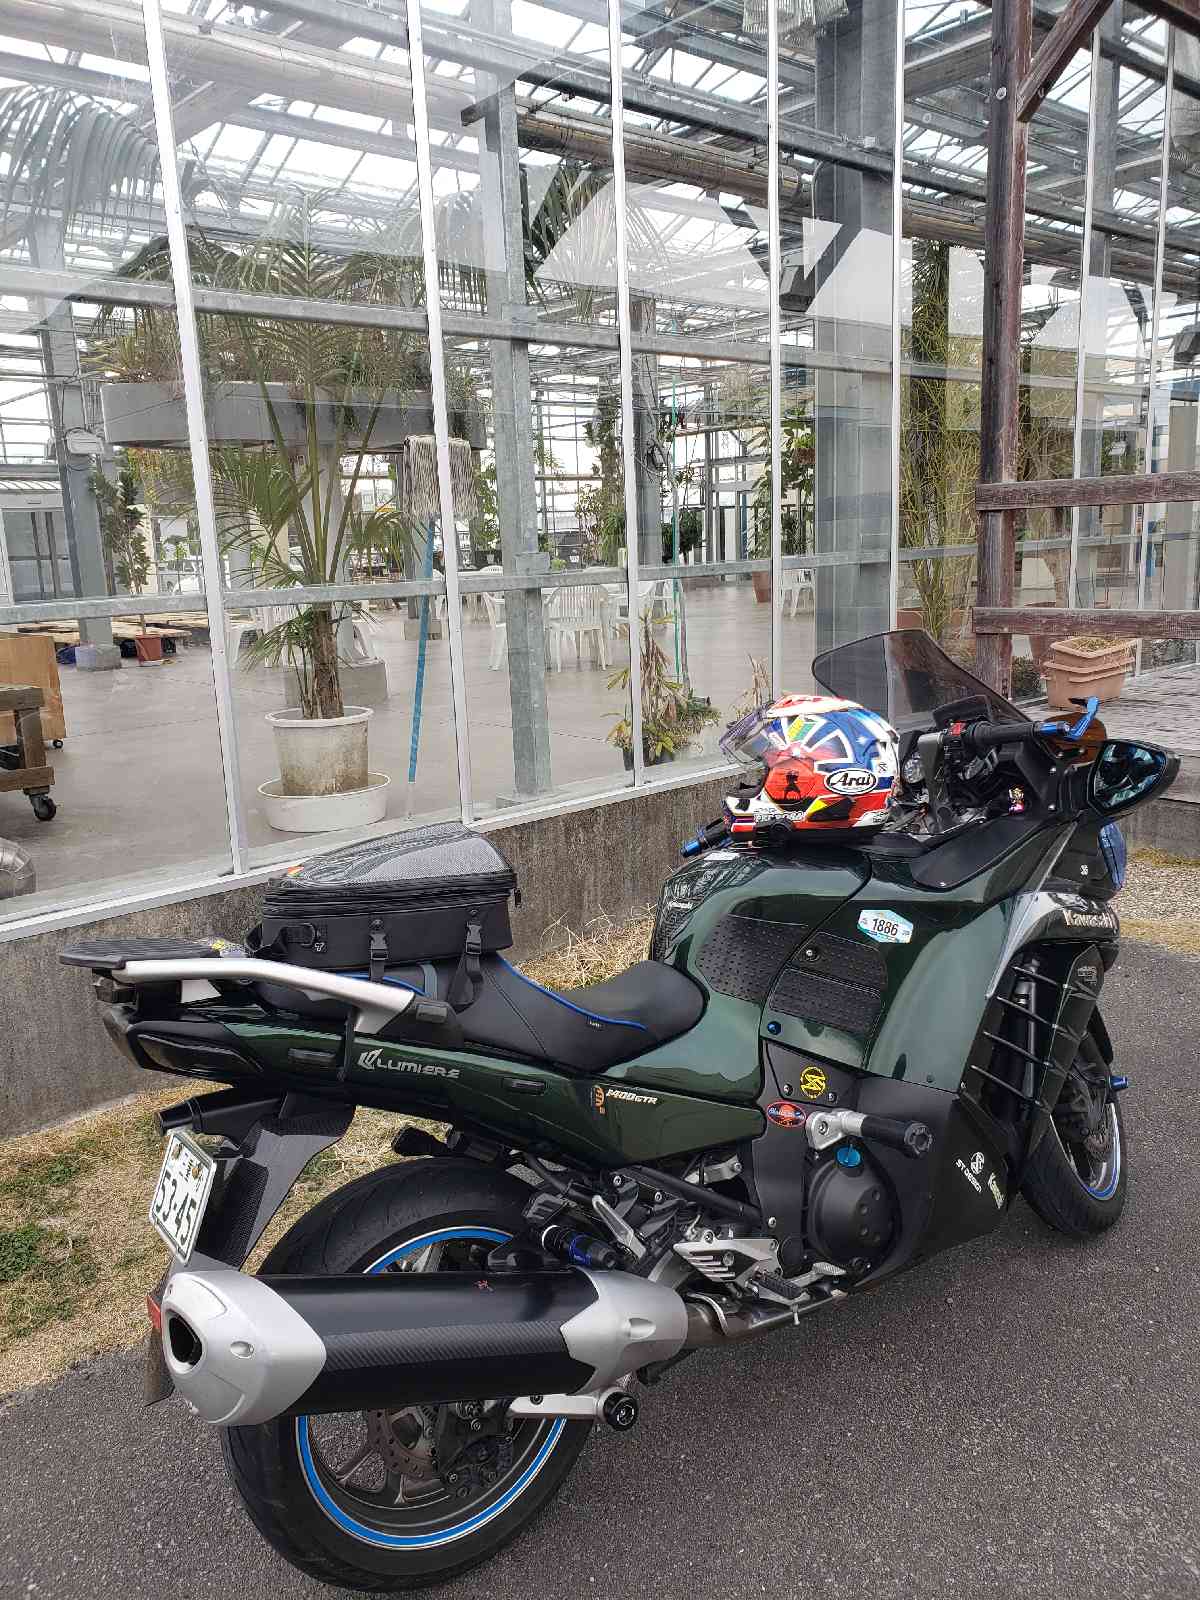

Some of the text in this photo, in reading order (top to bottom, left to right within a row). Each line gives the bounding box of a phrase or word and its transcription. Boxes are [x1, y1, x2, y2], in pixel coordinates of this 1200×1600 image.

[830, 772, 872, 786] Arai
[872, 918, 898, 936] 1886
[155, 1169, 197, 1246] 53-45
